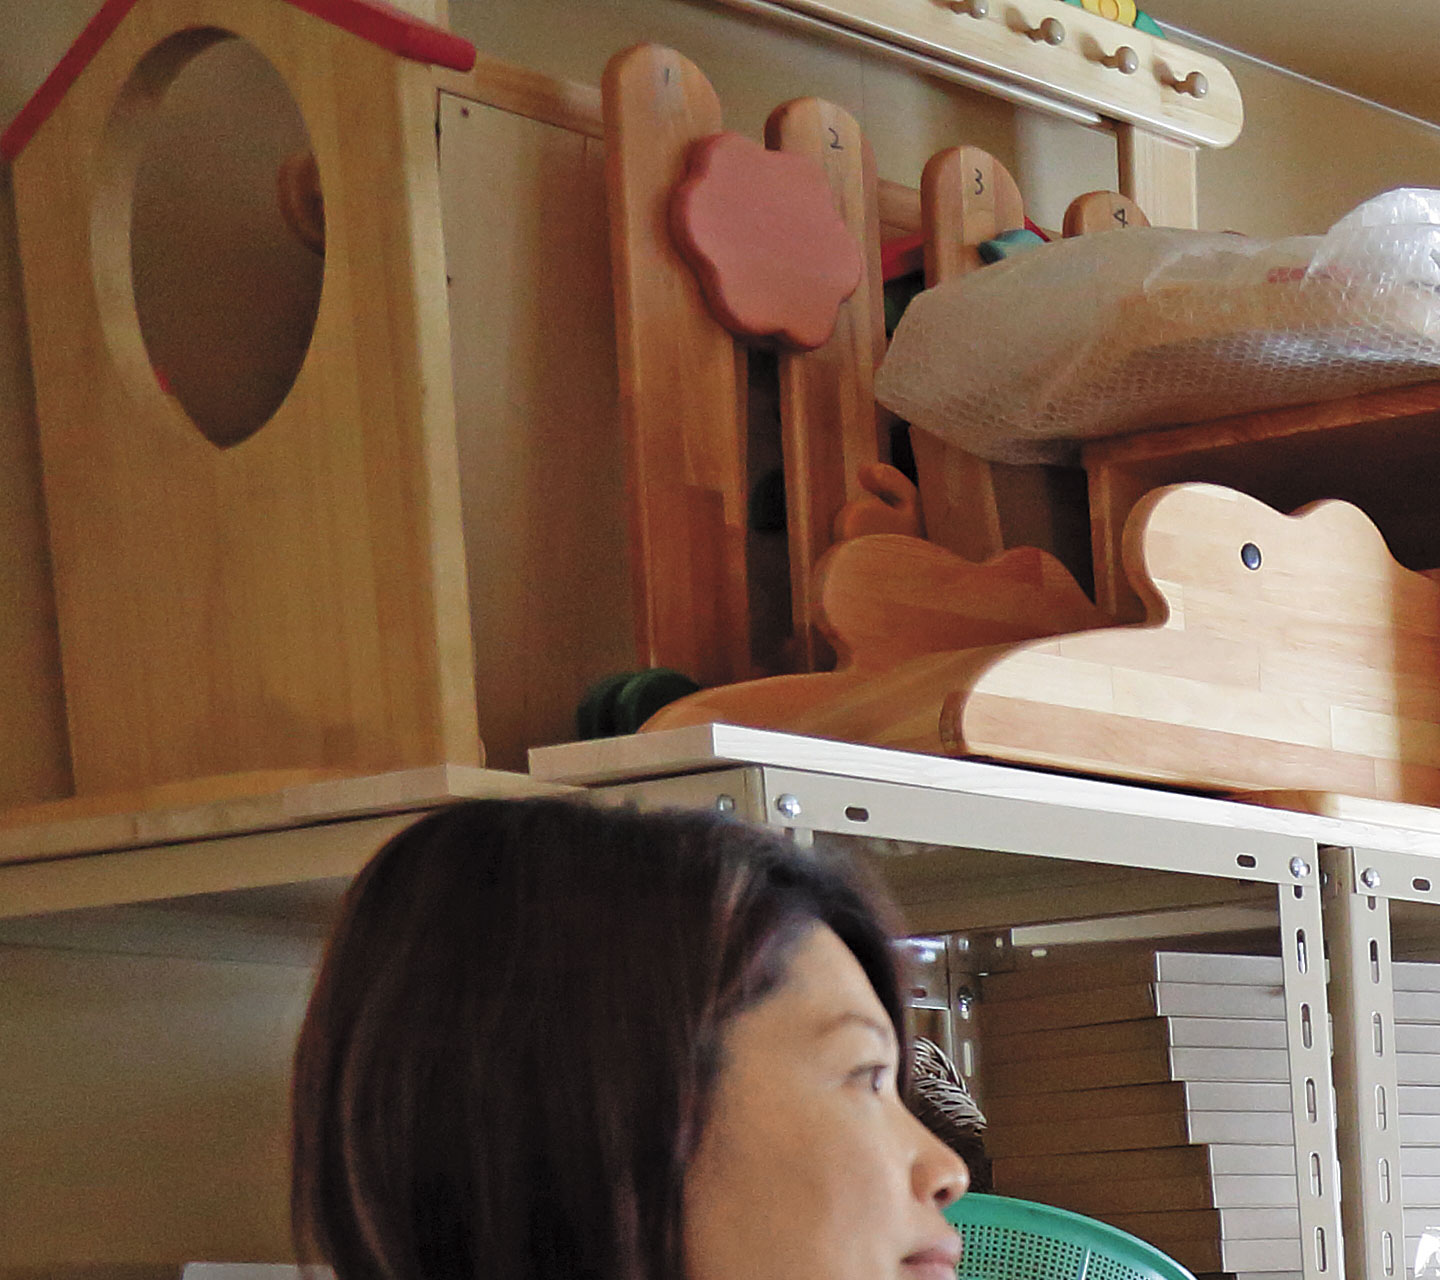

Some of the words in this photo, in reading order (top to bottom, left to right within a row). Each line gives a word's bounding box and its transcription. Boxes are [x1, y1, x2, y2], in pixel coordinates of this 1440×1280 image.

[828, 128, 844, 150] 2
[973, 167, 985, 196] 3
[1112, 207, 1129, 229] 4
